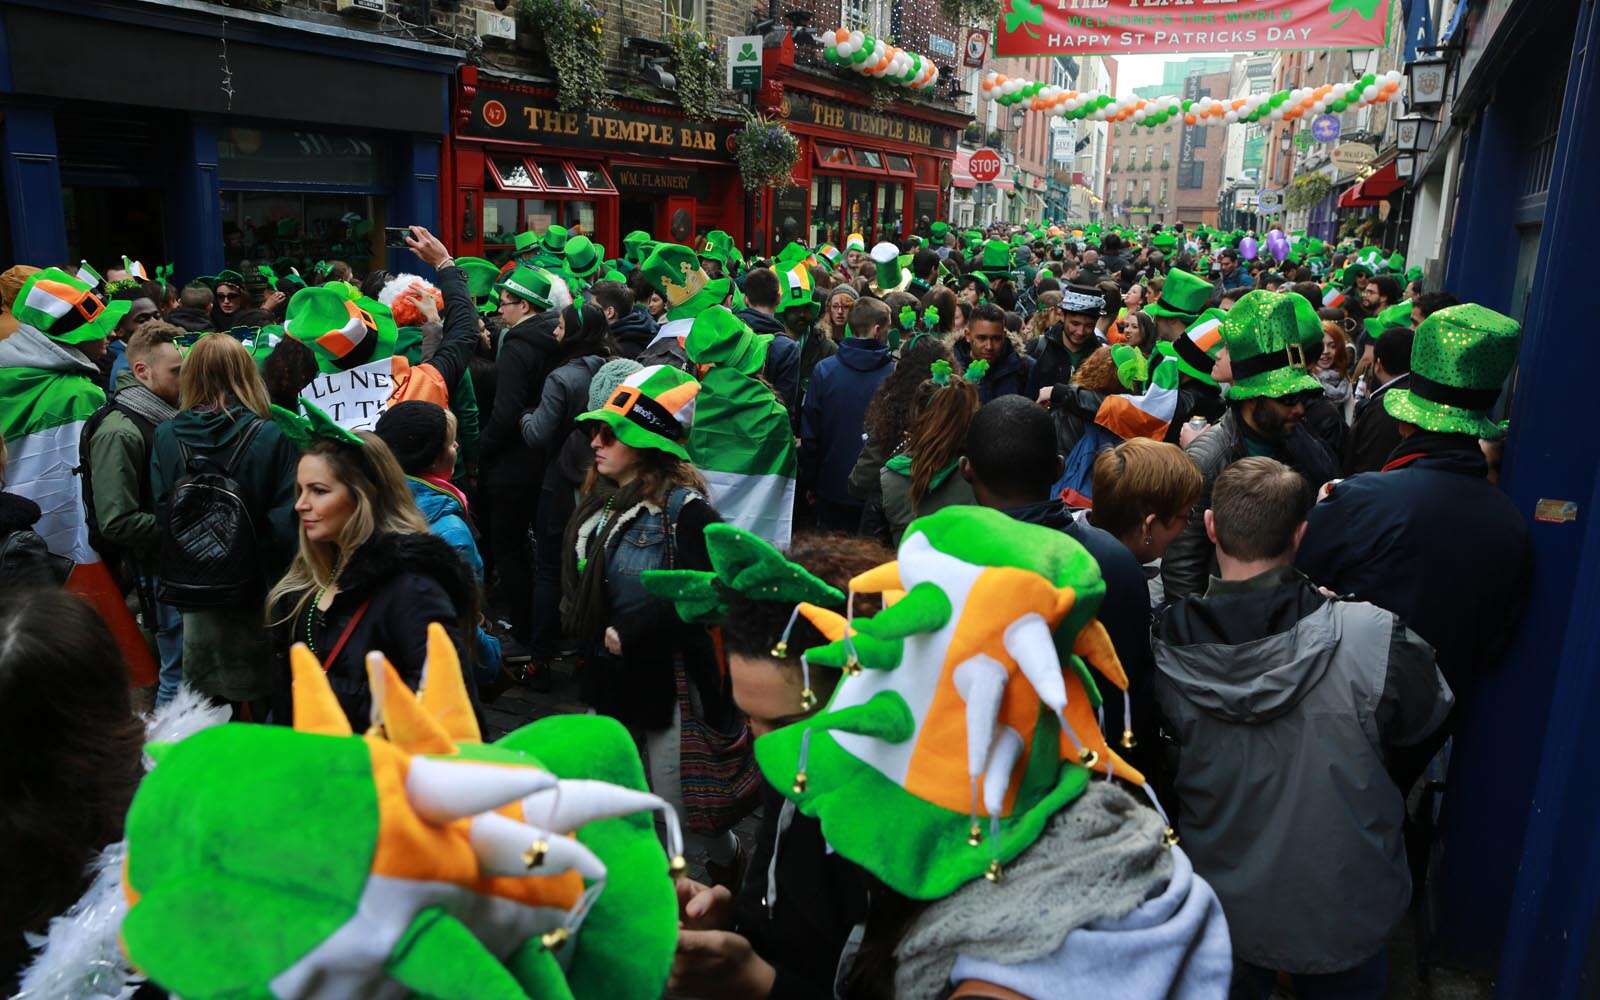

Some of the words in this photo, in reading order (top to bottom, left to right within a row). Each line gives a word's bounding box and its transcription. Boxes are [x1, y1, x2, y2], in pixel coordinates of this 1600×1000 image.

[1047, 33, 1111, 47] HAPPY
[1154, 30, 1257, 45] PATRICKS
[1266, 27, 1312, 42] DAY
[523, 106, 579, 135] THE
[586, 115, 674, 145] TEMPLE
[680, 128, 717, 150] BAR
[811, 101, 845, 129] THE
[851, 110, 904, 140] TEMPLE
[908, 125, 932, 146] BAR
[970, 159, 1000, 173] STOP
[641, 173, 690, 189] FLANNERY
